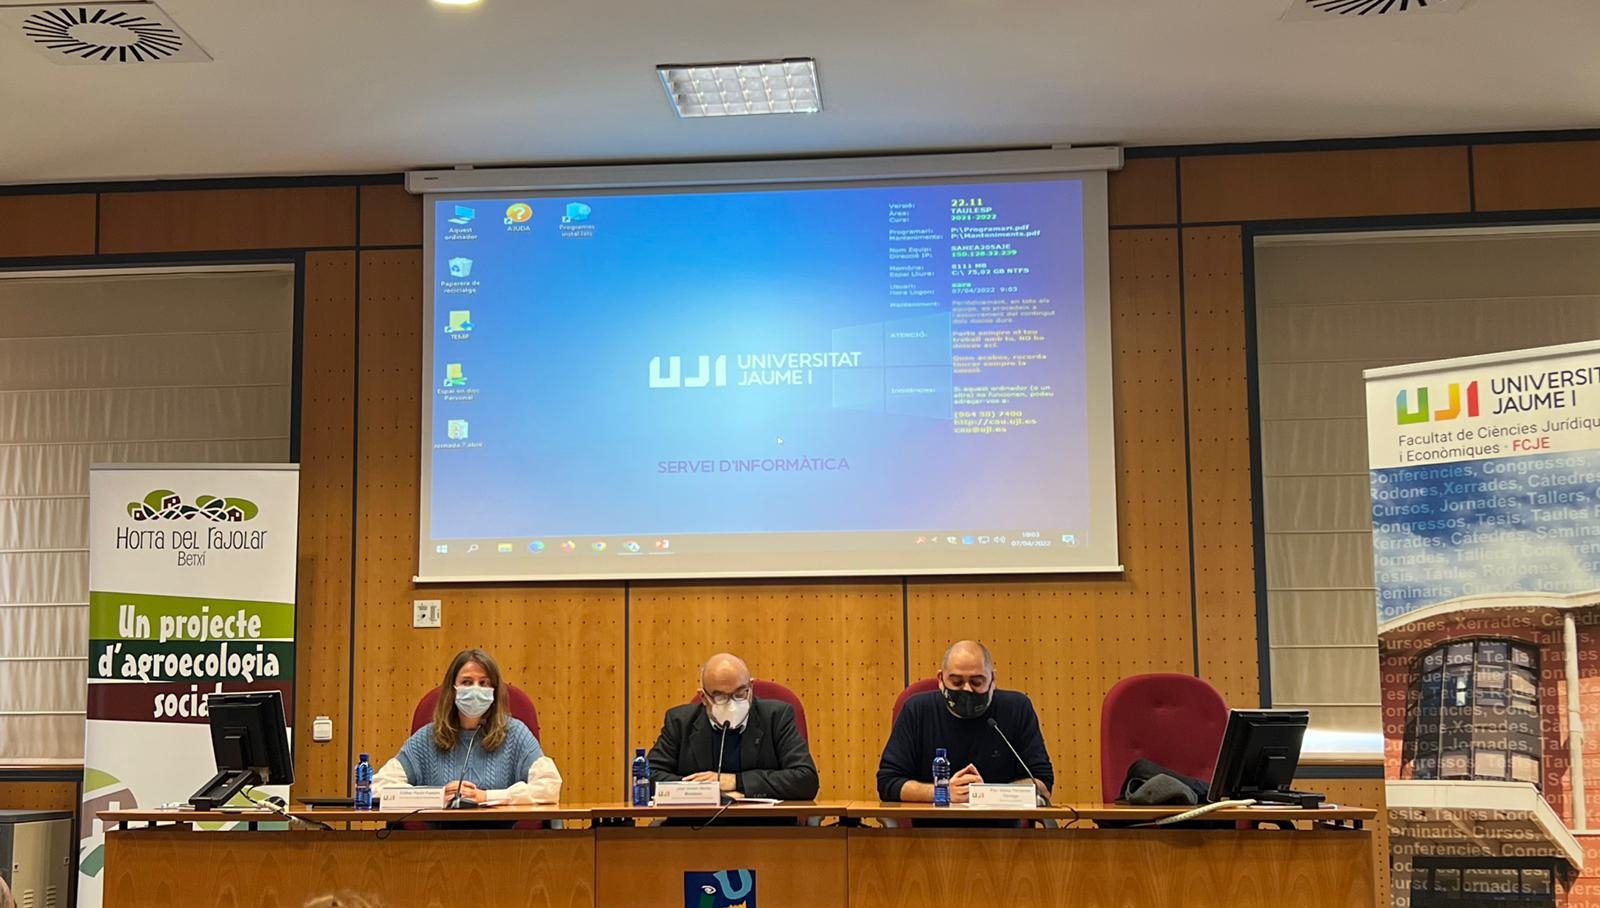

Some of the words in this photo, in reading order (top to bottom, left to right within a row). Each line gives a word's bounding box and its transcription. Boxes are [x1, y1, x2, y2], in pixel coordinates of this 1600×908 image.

[952, 198, 983, 207] 22.11
[649, 355, 726, 388] UJI
[738, 352, 862, 369] UNIVERSITAT
[738, 369, 802, 386] JAUME
[808, 370, 812, 384] I
[1396, 381, 1479, 425] UJI
[1492, 390, 1565, 414] JAUME
[1572, 390, 1576, 406] I
[1398, 431, 1452, 446] Facultat
[1456, 428, 1474, 440] de
[1478, 424, 1538, 438] Ciències
[1400, 452, 1403, 462] i
[1407, 443, 1500, 462] Econòmiques
[1512, 436, 1550, 452] FCJE
[658, 460, 714, 474] SERVEI
[720, 455, 850, 473] D'INFORMÀTICA
[1482, 456, 1592, 474] Congressos,
[1372, 504, 1434, 516] Cursos,
[1440, 496, 1522, 512] Jornades,
[1526, 490, 1590, 505] Tallers,
[1476, 512, 1526, 525] Tesis,
[1530, 507, 1588, 522] Taules
[119, 604, 150, 639] Un
[159, 606, 262, 643] projecte
[98, 642, 280, 683] d'agroecologia
[1390, 808, 1428, 822] esis,
[1387, 825, 1468, 840] eminaris,
